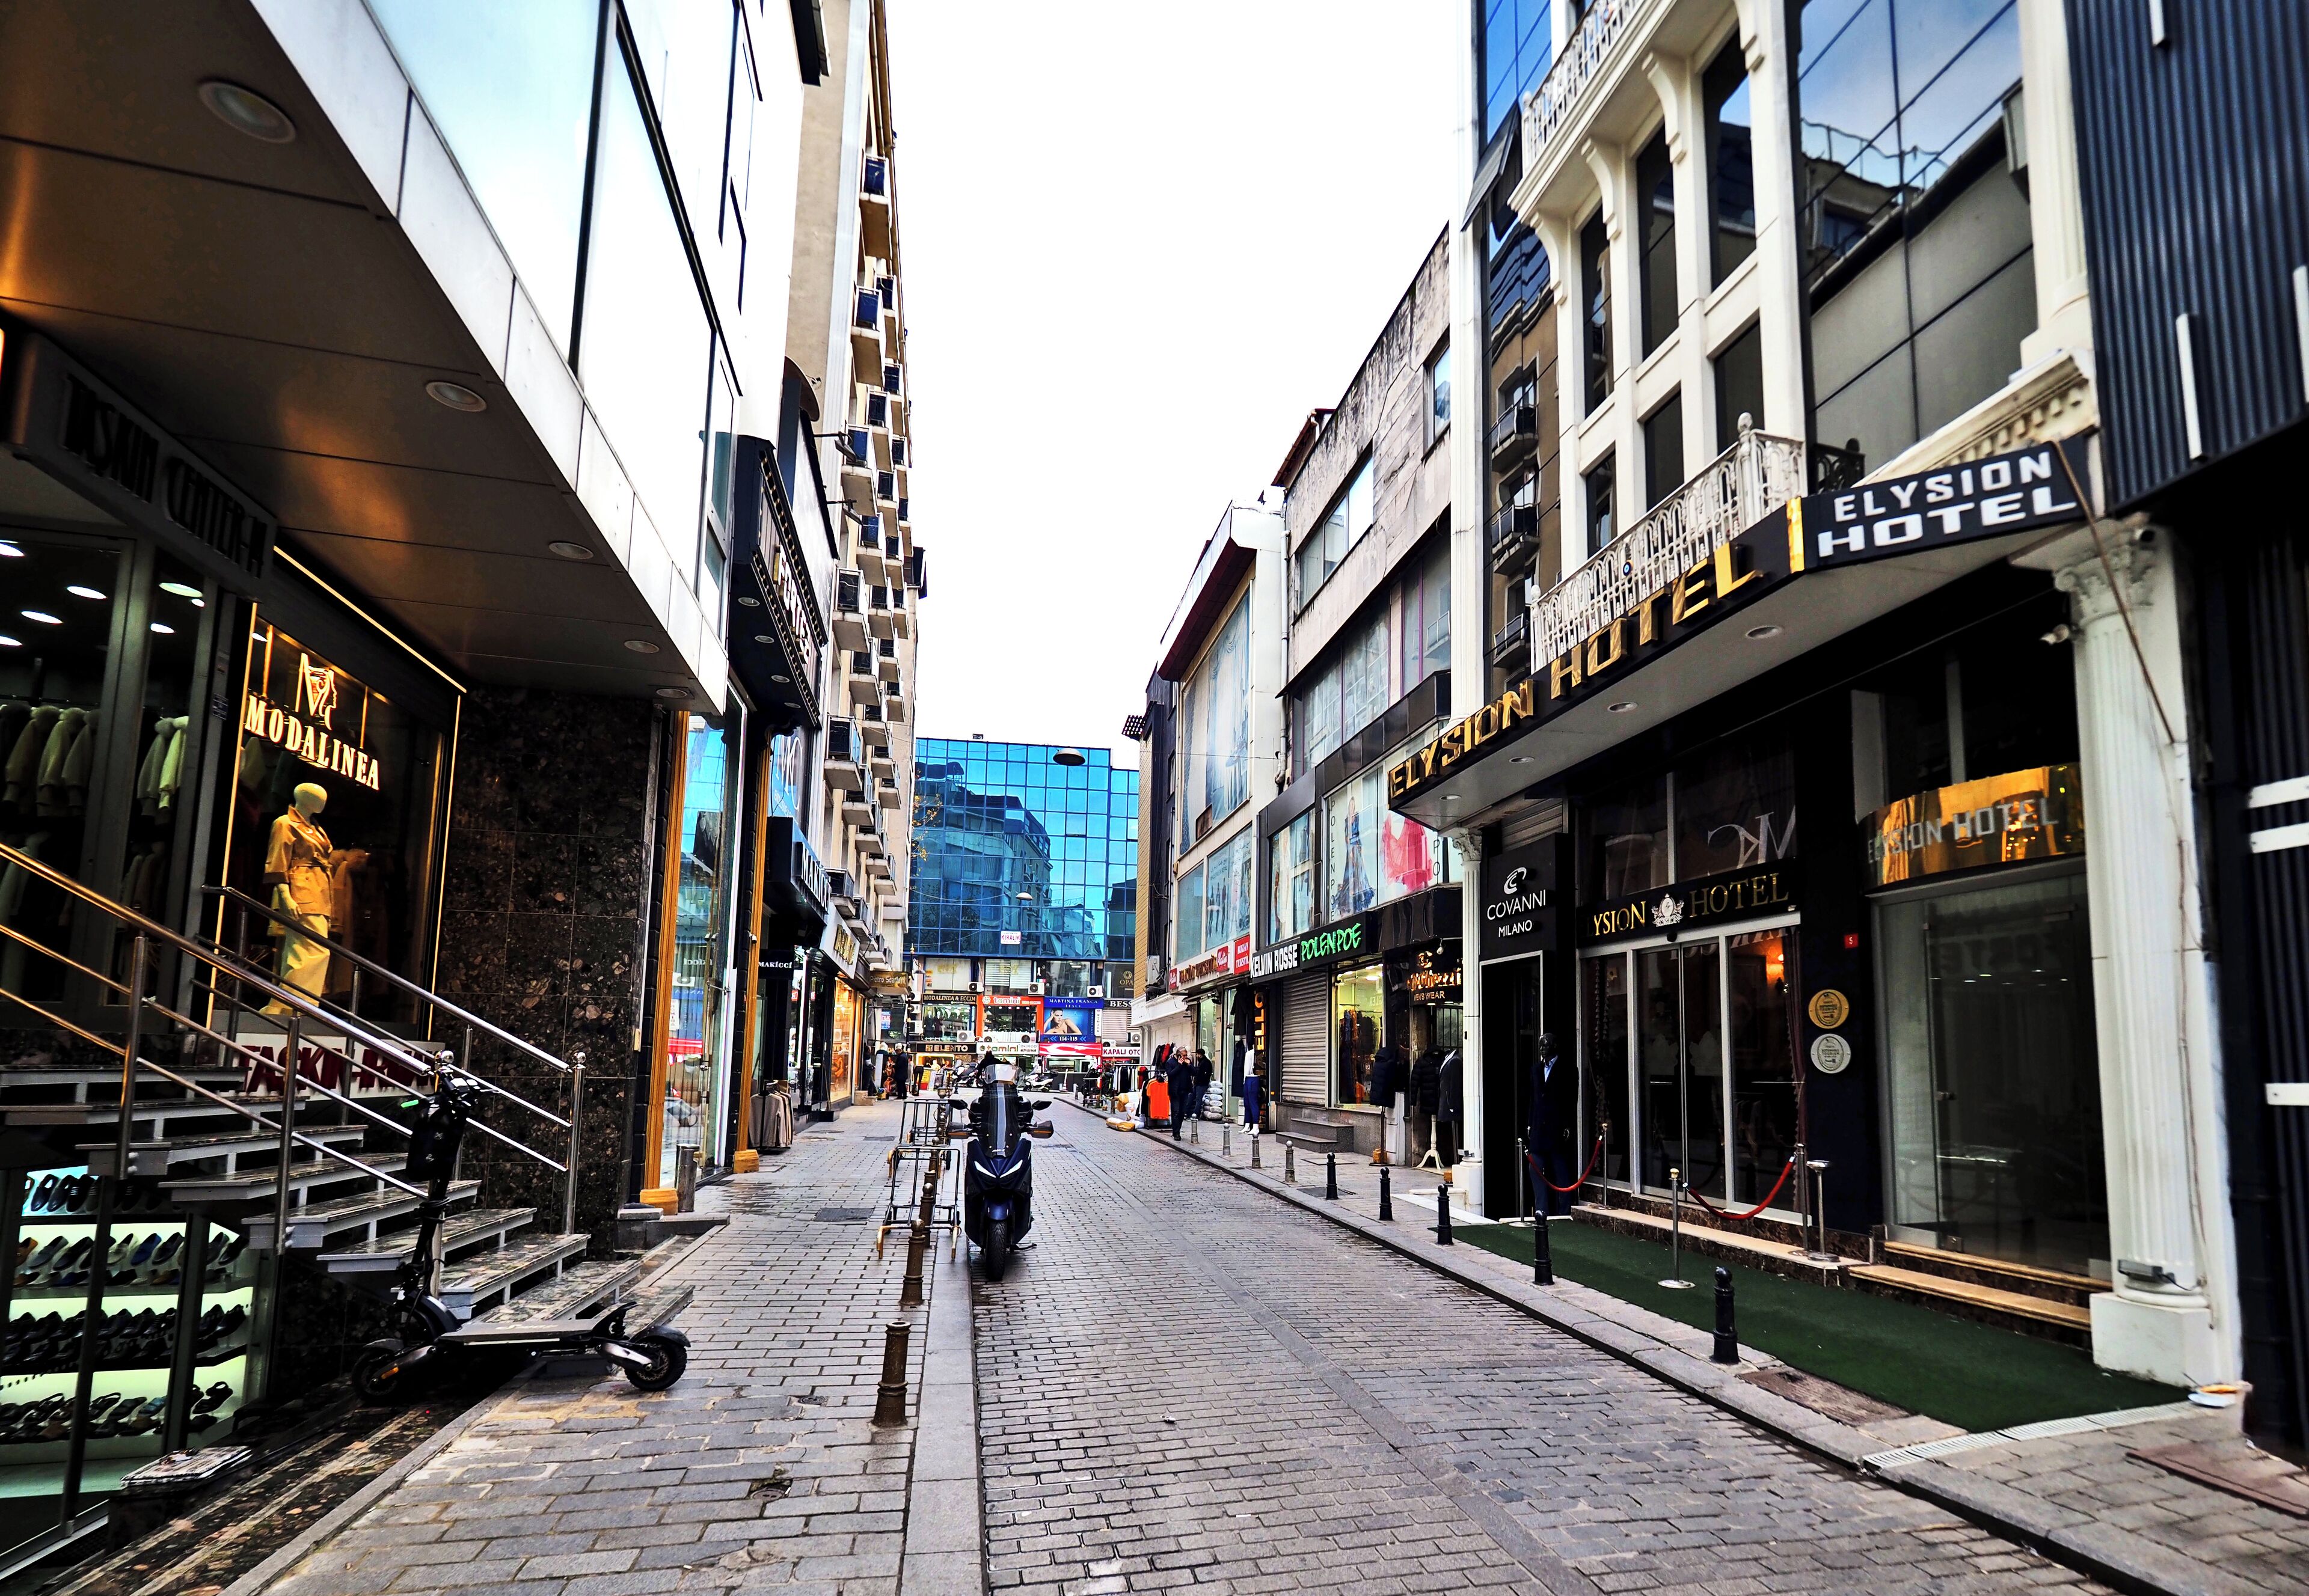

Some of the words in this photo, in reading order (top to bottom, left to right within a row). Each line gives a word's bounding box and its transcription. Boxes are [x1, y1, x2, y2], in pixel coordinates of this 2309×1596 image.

[1835, 451, 2052, 522] ELYSION
[1818, 487, 2077, 557] HOTEL
[1390, 680, 1533, 798] ELYSION
[1551, 542, 1762, 699] HOTEL
[245, 696, 379, 790] MODALINEA
[1953, 796, 2059, 840] HOTEL
[1487, 890, 1545, 920] COVANNI
[1690, 873, 1789, 917] HOTEL
[1498, 920, 1532, 937] MILANO
[1250, 952, 1273, 978] KELVIN
[1274, 944, 1298, 971] ROSSE
[1426, 991, 1445, 1000] WEAR
